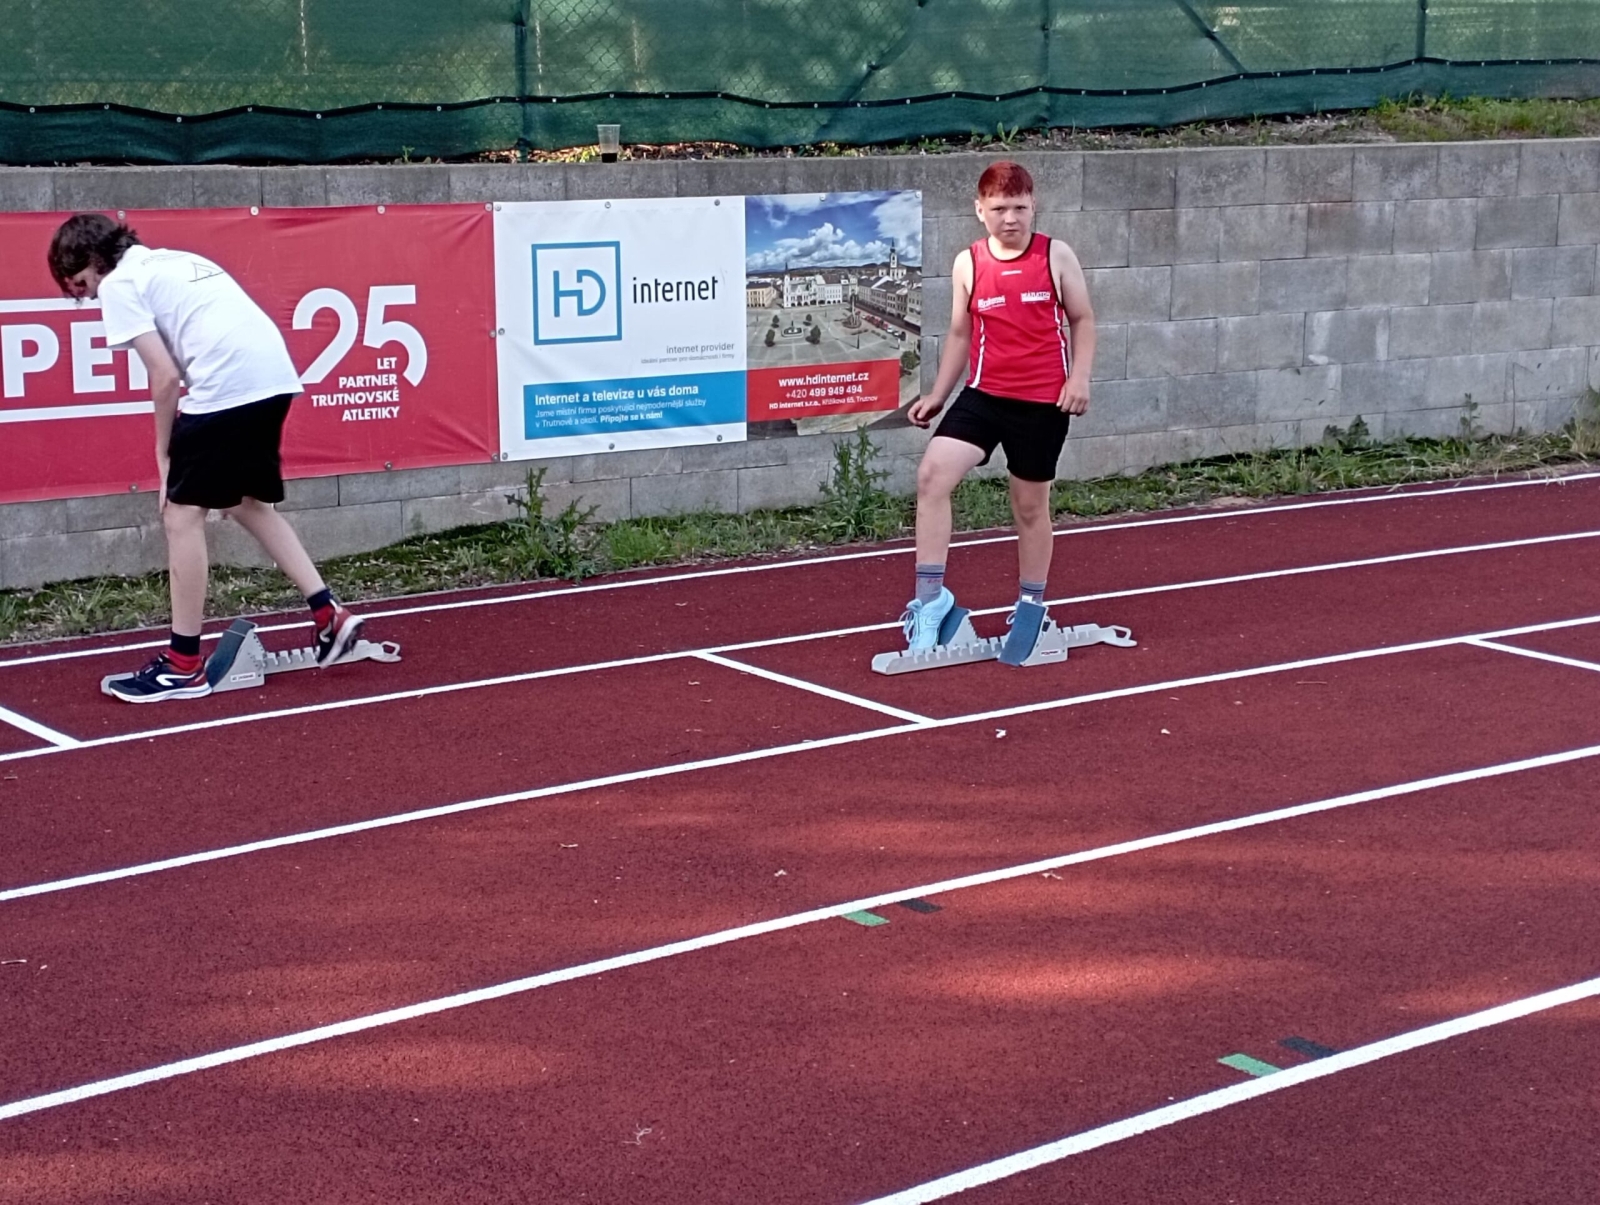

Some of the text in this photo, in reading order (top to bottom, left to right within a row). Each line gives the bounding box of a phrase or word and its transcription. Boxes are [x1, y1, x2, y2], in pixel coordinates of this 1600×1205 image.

[553, 269, 718, 318] HD internet
[292, 284, 427, 387] 25
[666, 343, 734, 355] internet provider
[377, 357, 397, 370] LET
[339, 374, 397, 388] PARTNER
[778, 372, 869, 387] www.hdinternet.cz
[311, 387, 399, 407] TRUTNOVSKÉ
[535, 385, 699, 406] Internet a televize u vás doma
[785, 385, 862, 398] +420 499 949 494
[769, 402, 778, 410] HD
[779, 401, 804, 409] internet
[342, 406, 400, 421] ATLETIKY
[535, 410, 554, 418] Jsme
